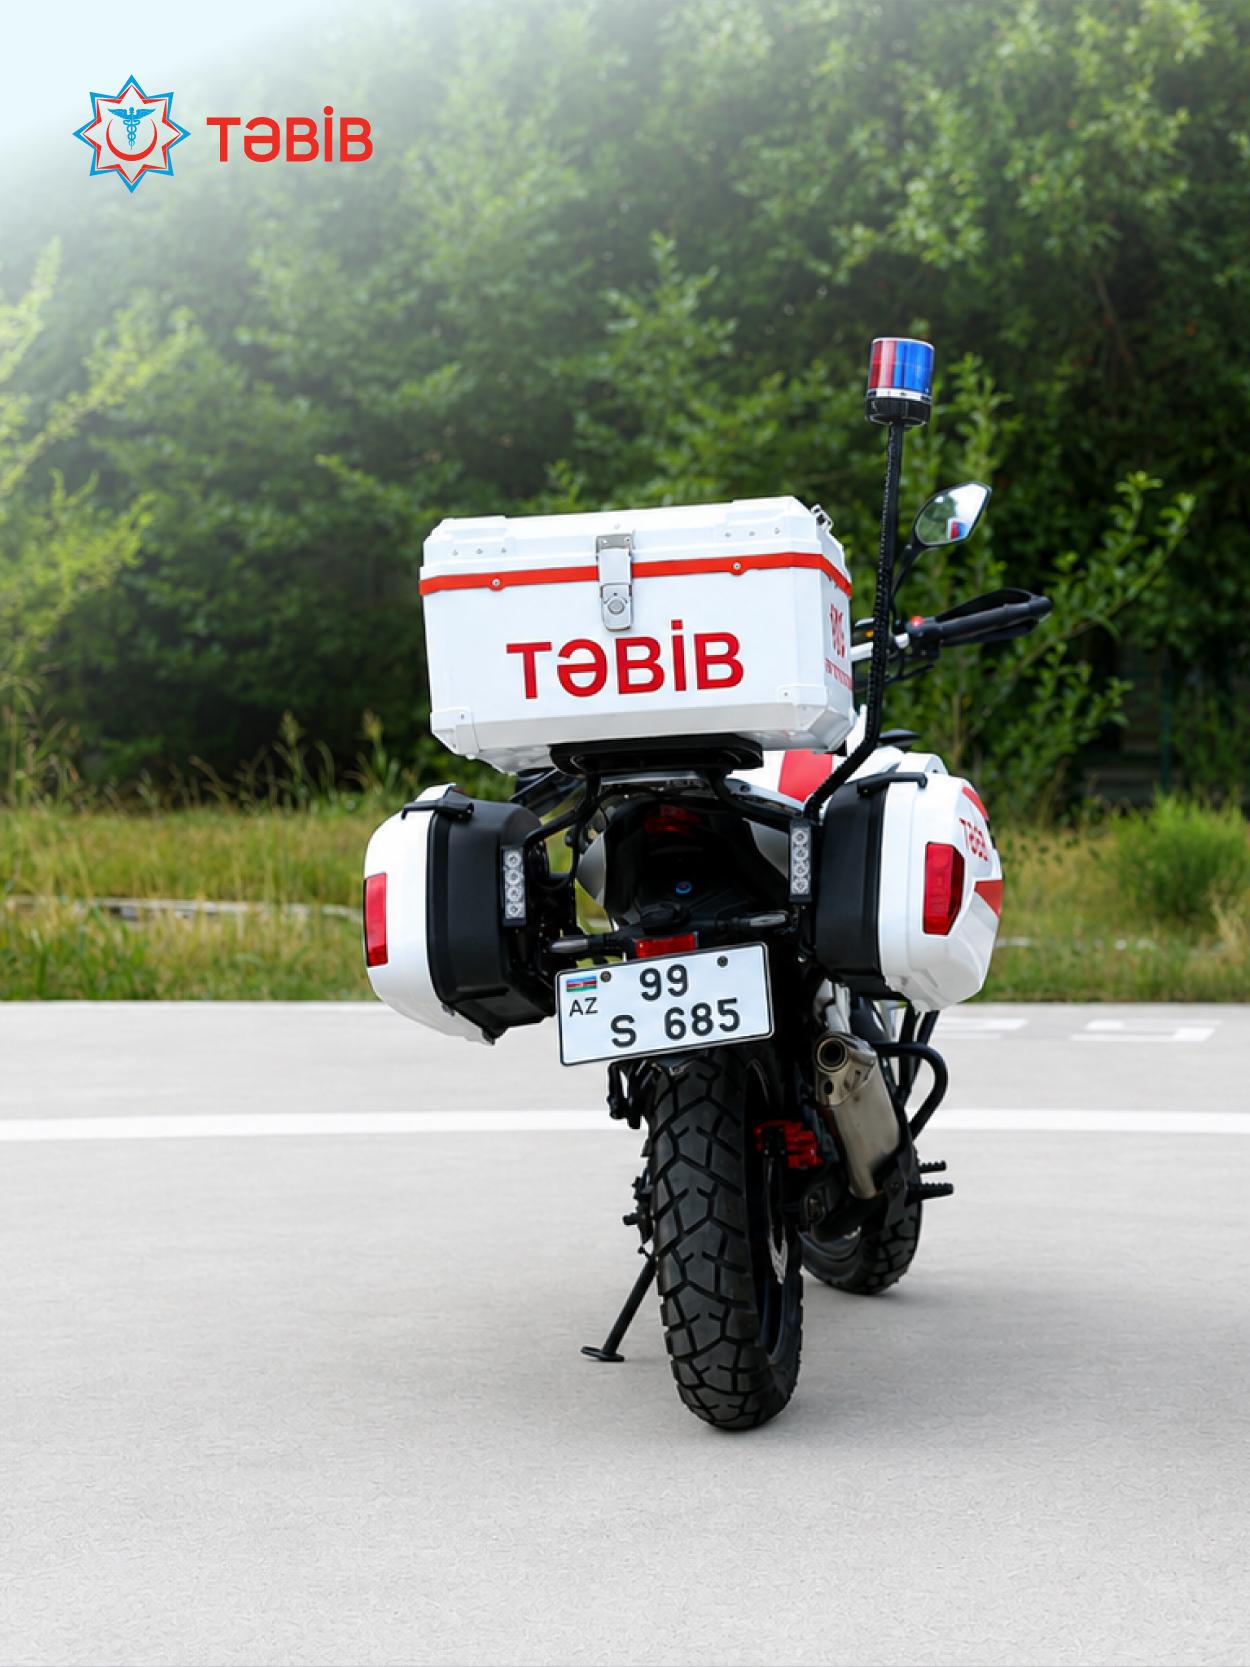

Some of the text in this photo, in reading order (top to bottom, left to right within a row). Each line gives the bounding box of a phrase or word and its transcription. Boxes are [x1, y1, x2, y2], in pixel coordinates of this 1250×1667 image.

[506, 619, 744, 700] TƏBİB
[639, 964, 688, 1001] 99
[569, 997, 598, 1017] AZ
[611, 997, 740, 1048] S 685
